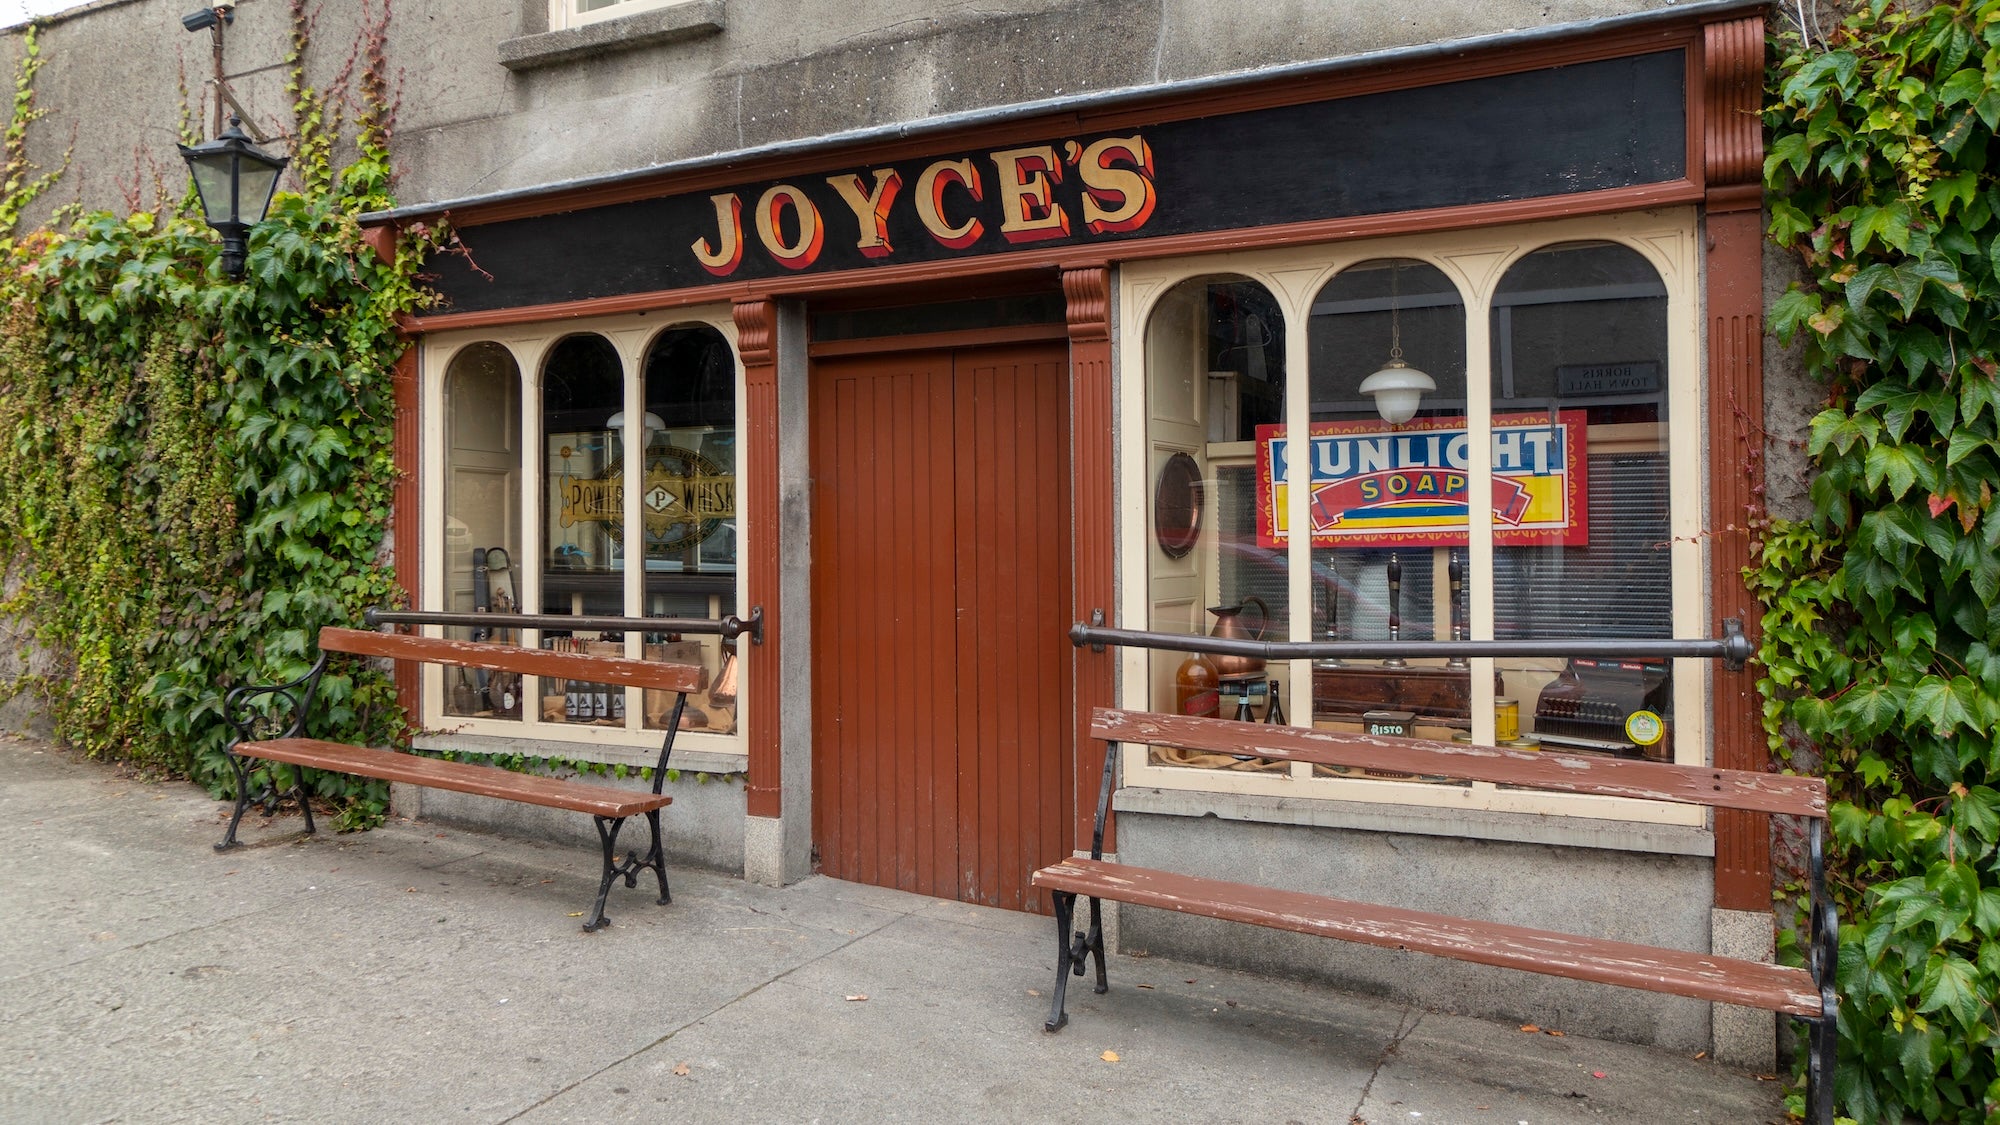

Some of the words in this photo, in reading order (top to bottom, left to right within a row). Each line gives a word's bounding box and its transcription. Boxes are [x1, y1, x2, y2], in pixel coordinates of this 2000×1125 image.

[691, 134, 1156, 277] JOYCE'S
[1360, 475, 1465, 499] SOAP
[1371, 724, 1403, 736] BISTO
